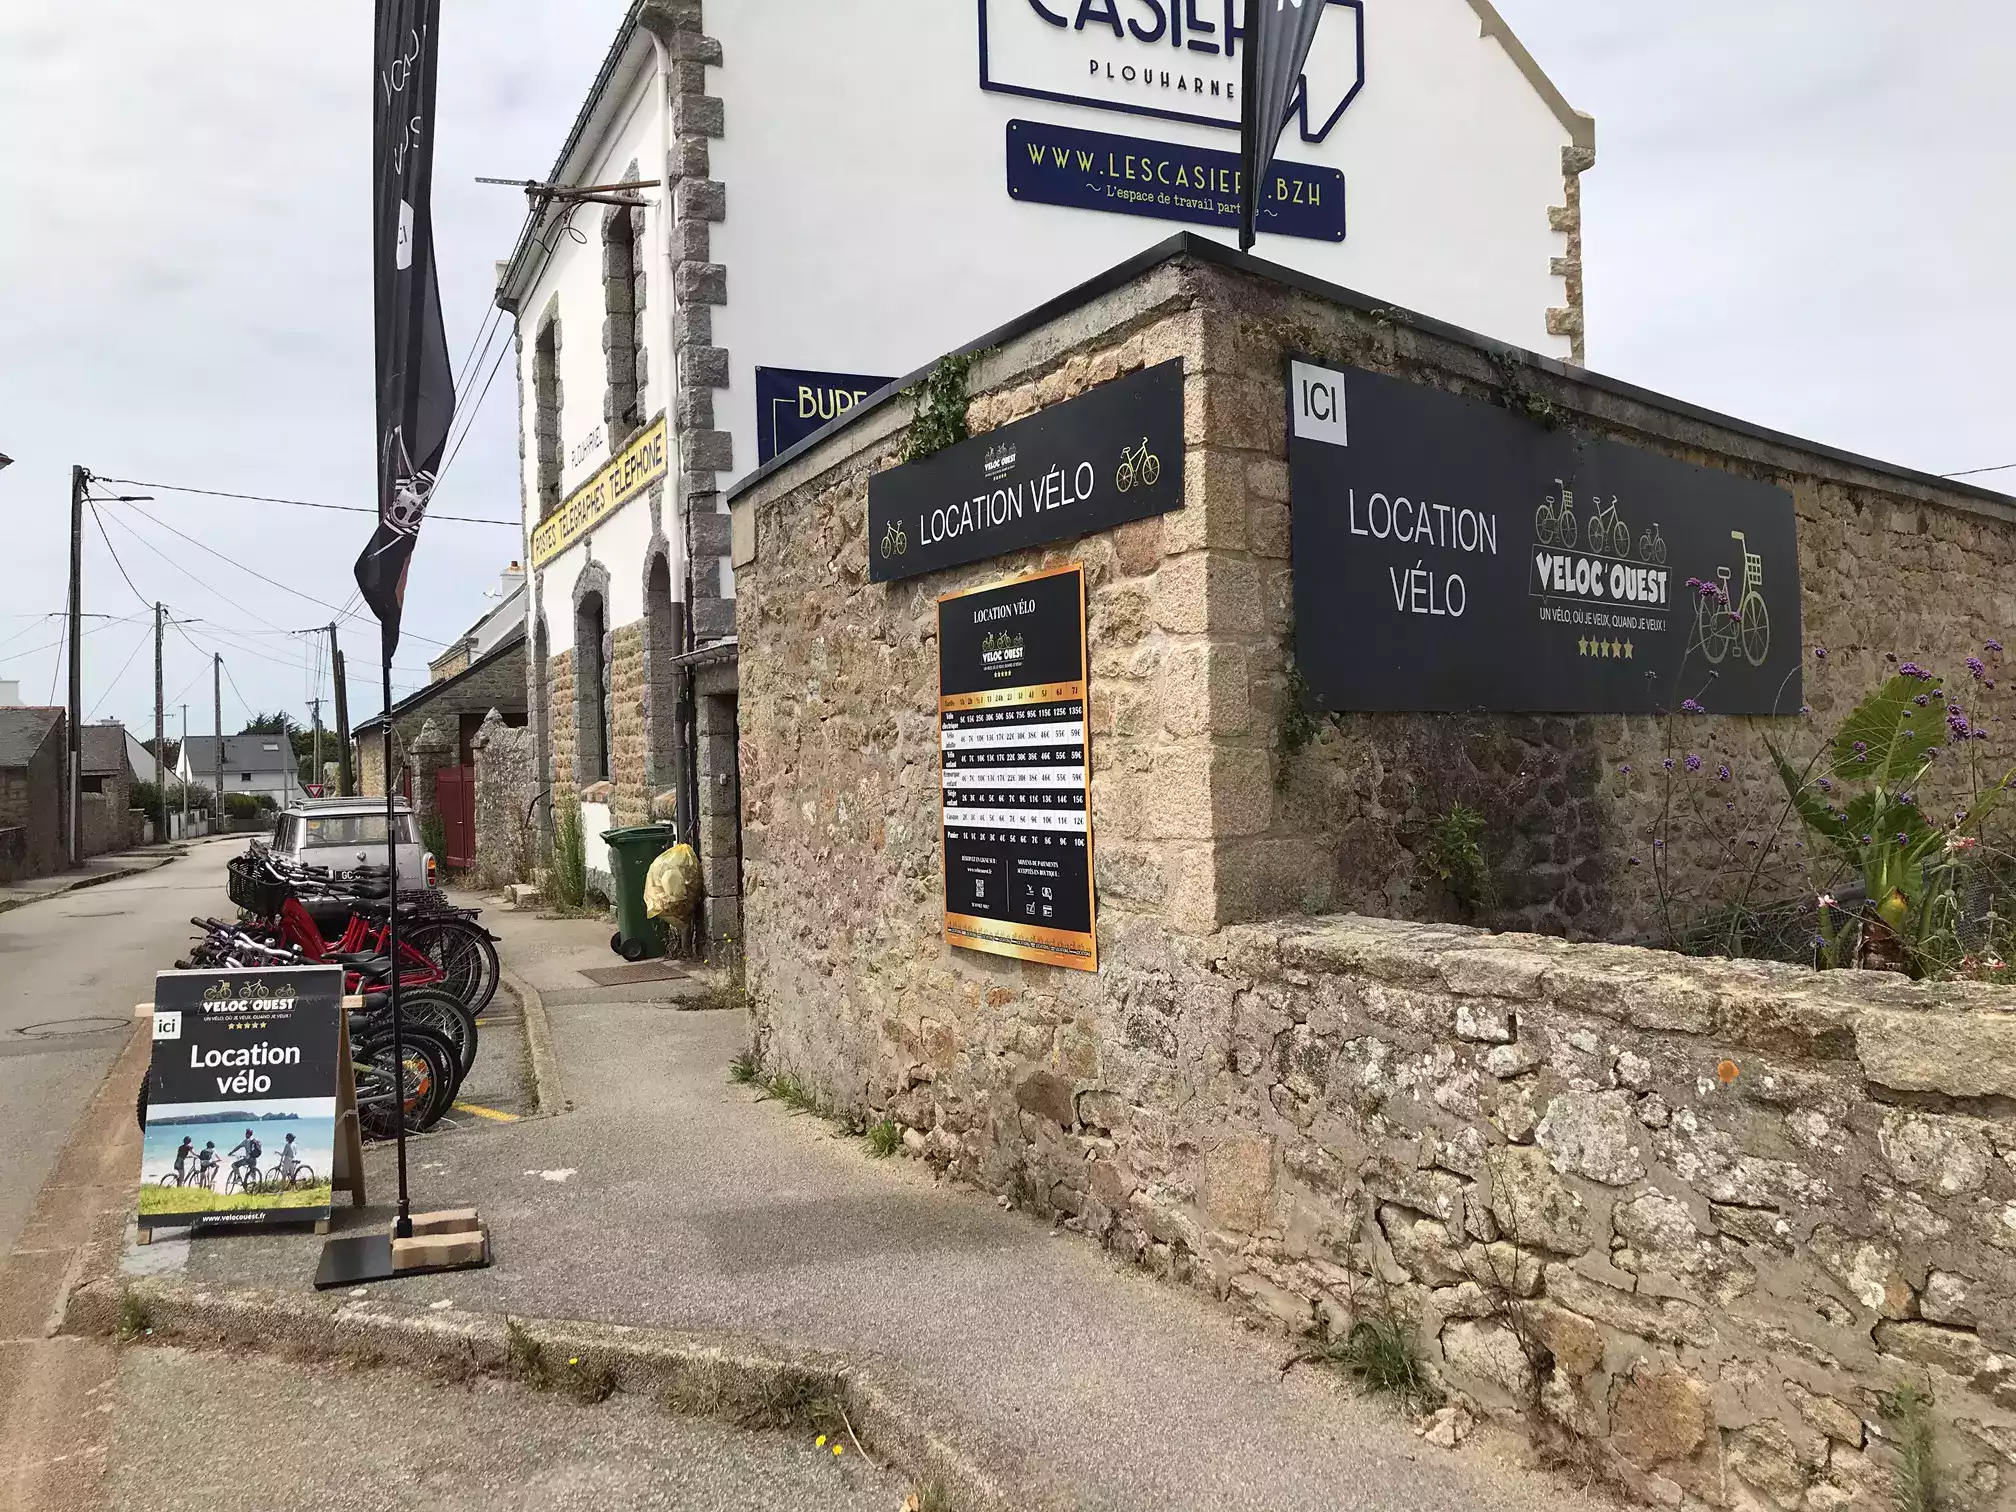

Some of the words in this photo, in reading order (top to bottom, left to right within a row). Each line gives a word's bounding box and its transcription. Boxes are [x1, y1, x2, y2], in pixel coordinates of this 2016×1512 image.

[1089, 59, 1235, 99] PLOUHARNE
[1027, 142, 1321, 206] WWW.LESCASIE.BZH
[1107, 184, 1154, 203] L'espace
[1157, 192, 1171, 205] de
[1172, 194, 1214, 211] travail
[1302, 379, 1337, 423] ICI
[920, 483, 1023, 546] LOCATION
[1030, 463, 1094, 513] VÉLO
[1349, 488, 1497, 554] LOCATION
[1389, 559, 1466, 617] VÉLO
[973, 603, 1012, 624] LOCATION
[1013, 598, 1036, 615] VÉLO
[1539, 607, 1551, 621] UN
[1552, 605, 1572, 625] VÉLO,
[1572, 608, 1584, 624] OÙ
[1584, 612, 1592, 625] JE
[1592, 613, 1611, 628] VEUX,
[1612, 615, 1637, 629] QUAND
[1638, 618, 1646, 630] JE
[1646, 618, 1662, 631] VEUX
[1038, 709, 1051, 717] 115€
[1053, 708, 1066, 716] 125€
[1069, 706, 1082, 715] 135€
[1073, 795, 1083, 803] 15€
[203, 998, 295, 1013] VELOC'OUEST
[158, 1019, 176, 1033] ici
[190, 1041, 301, 1068] Location
[216, 1068, 271, 1094] vélo
[202, 1212, 267, 1222] www.velocouest.fr
